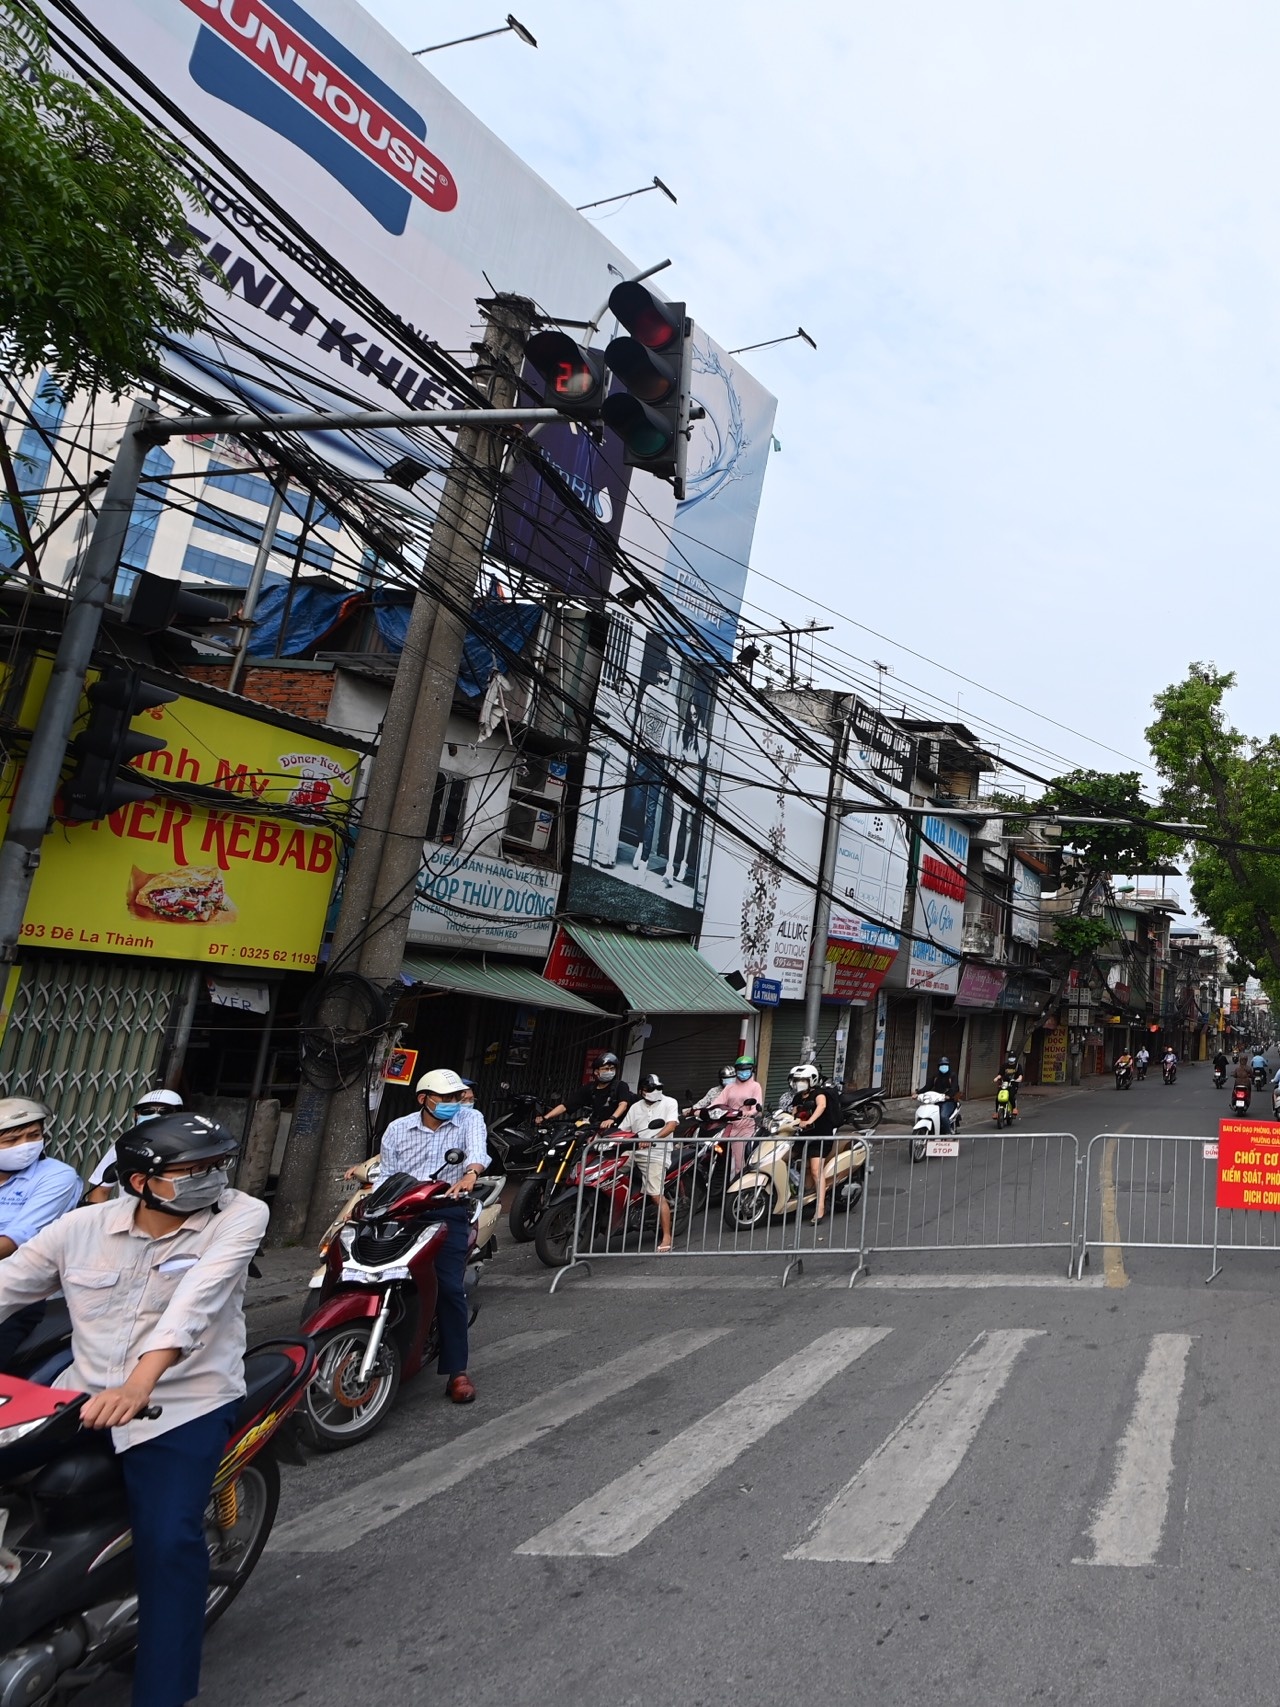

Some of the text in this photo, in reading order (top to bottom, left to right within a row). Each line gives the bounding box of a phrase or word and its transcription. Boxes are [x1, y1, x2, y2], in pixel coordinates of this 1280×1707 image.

[199, 808, 335, 874] KEBAB
[838, 848, 860, 861] NOKIA
[460, 857, 484, 874] BÁN
[484, 863, 514, 879] HÀNG
[415, 871, 555, 917] SHOP THÙY DƯƠNG
[844, 886, 855, 899] LG
[50, 925, 74, 942] Đê
[79, 929, 100, 944] La
[106, 931, 154, 949] Thành
[485, 927, 504, 937] BÁNH
[776, 920, 809, 942] ALLURE
[208, 943, 229, 956] ĐT
[239, 946, 270, 961] 0325
[272, 950, 287, 963] 62
[291, 952, 317, 965] 1193
[774, 942, 807, 958] BOUTIQUE
[753, 990, 778, 1003] LA THÀNH
[1234, 1148, 1262, 1165] CHỐT
[1263, 1152, 1279, 1167] CƠ
[1221, 1165, 1241, 1183] KIỂM
[1242, 1168, 1264, 1186] SOÁT,
[1243, 1190, 1262, 1206] DỊCH
